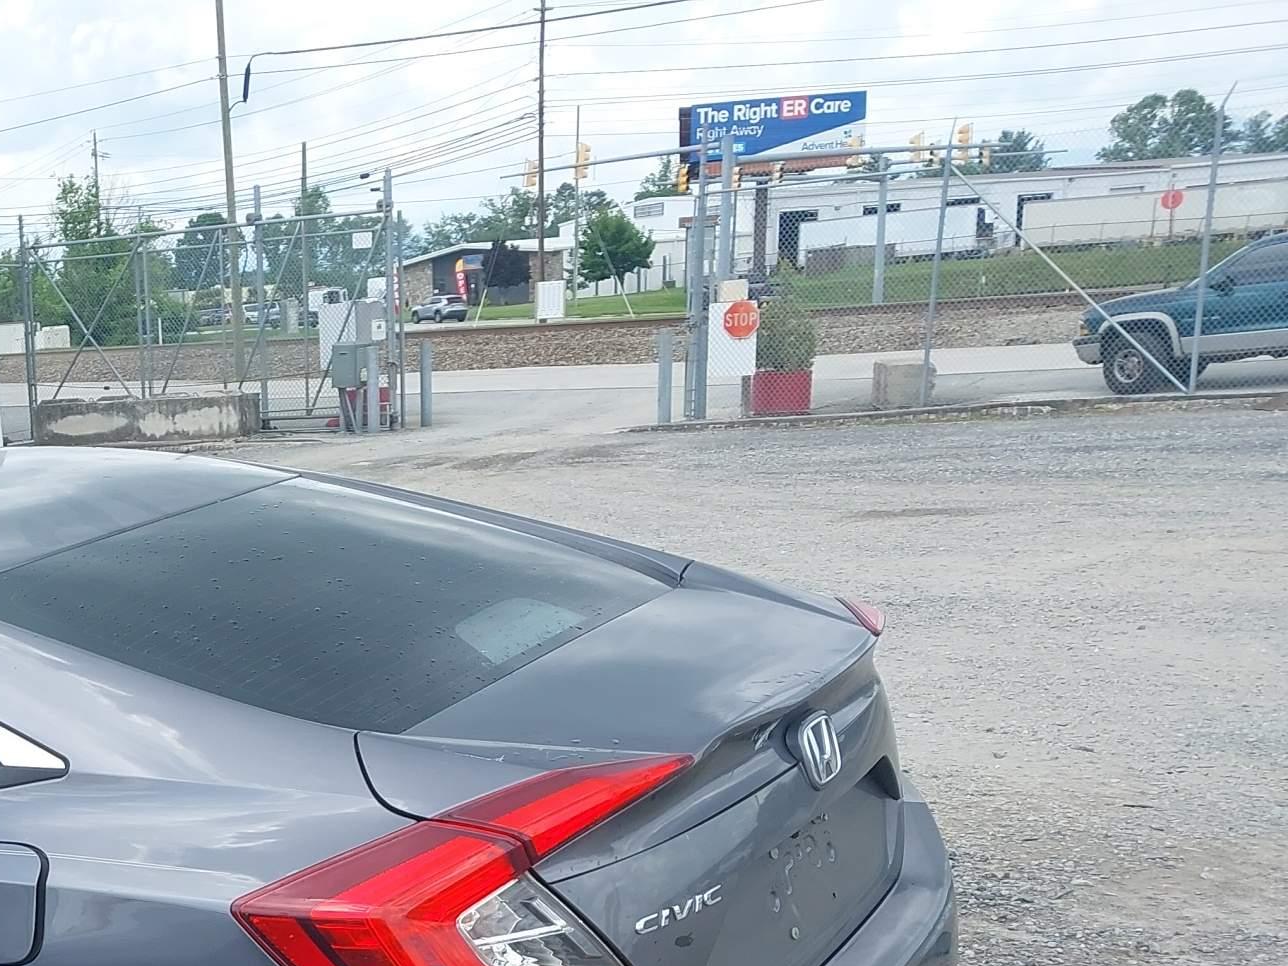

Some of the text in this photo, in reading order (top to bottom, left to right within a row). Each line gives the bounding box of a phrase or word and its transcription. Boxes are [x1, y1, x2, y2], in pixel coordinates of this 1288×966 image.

[697, 98, 851, 124] The Right ER Care
[696, 124, 764, 142] Rght Away
[725, 312, 757, 327] STOP
[635, 884, 722, 935] CIVIC
